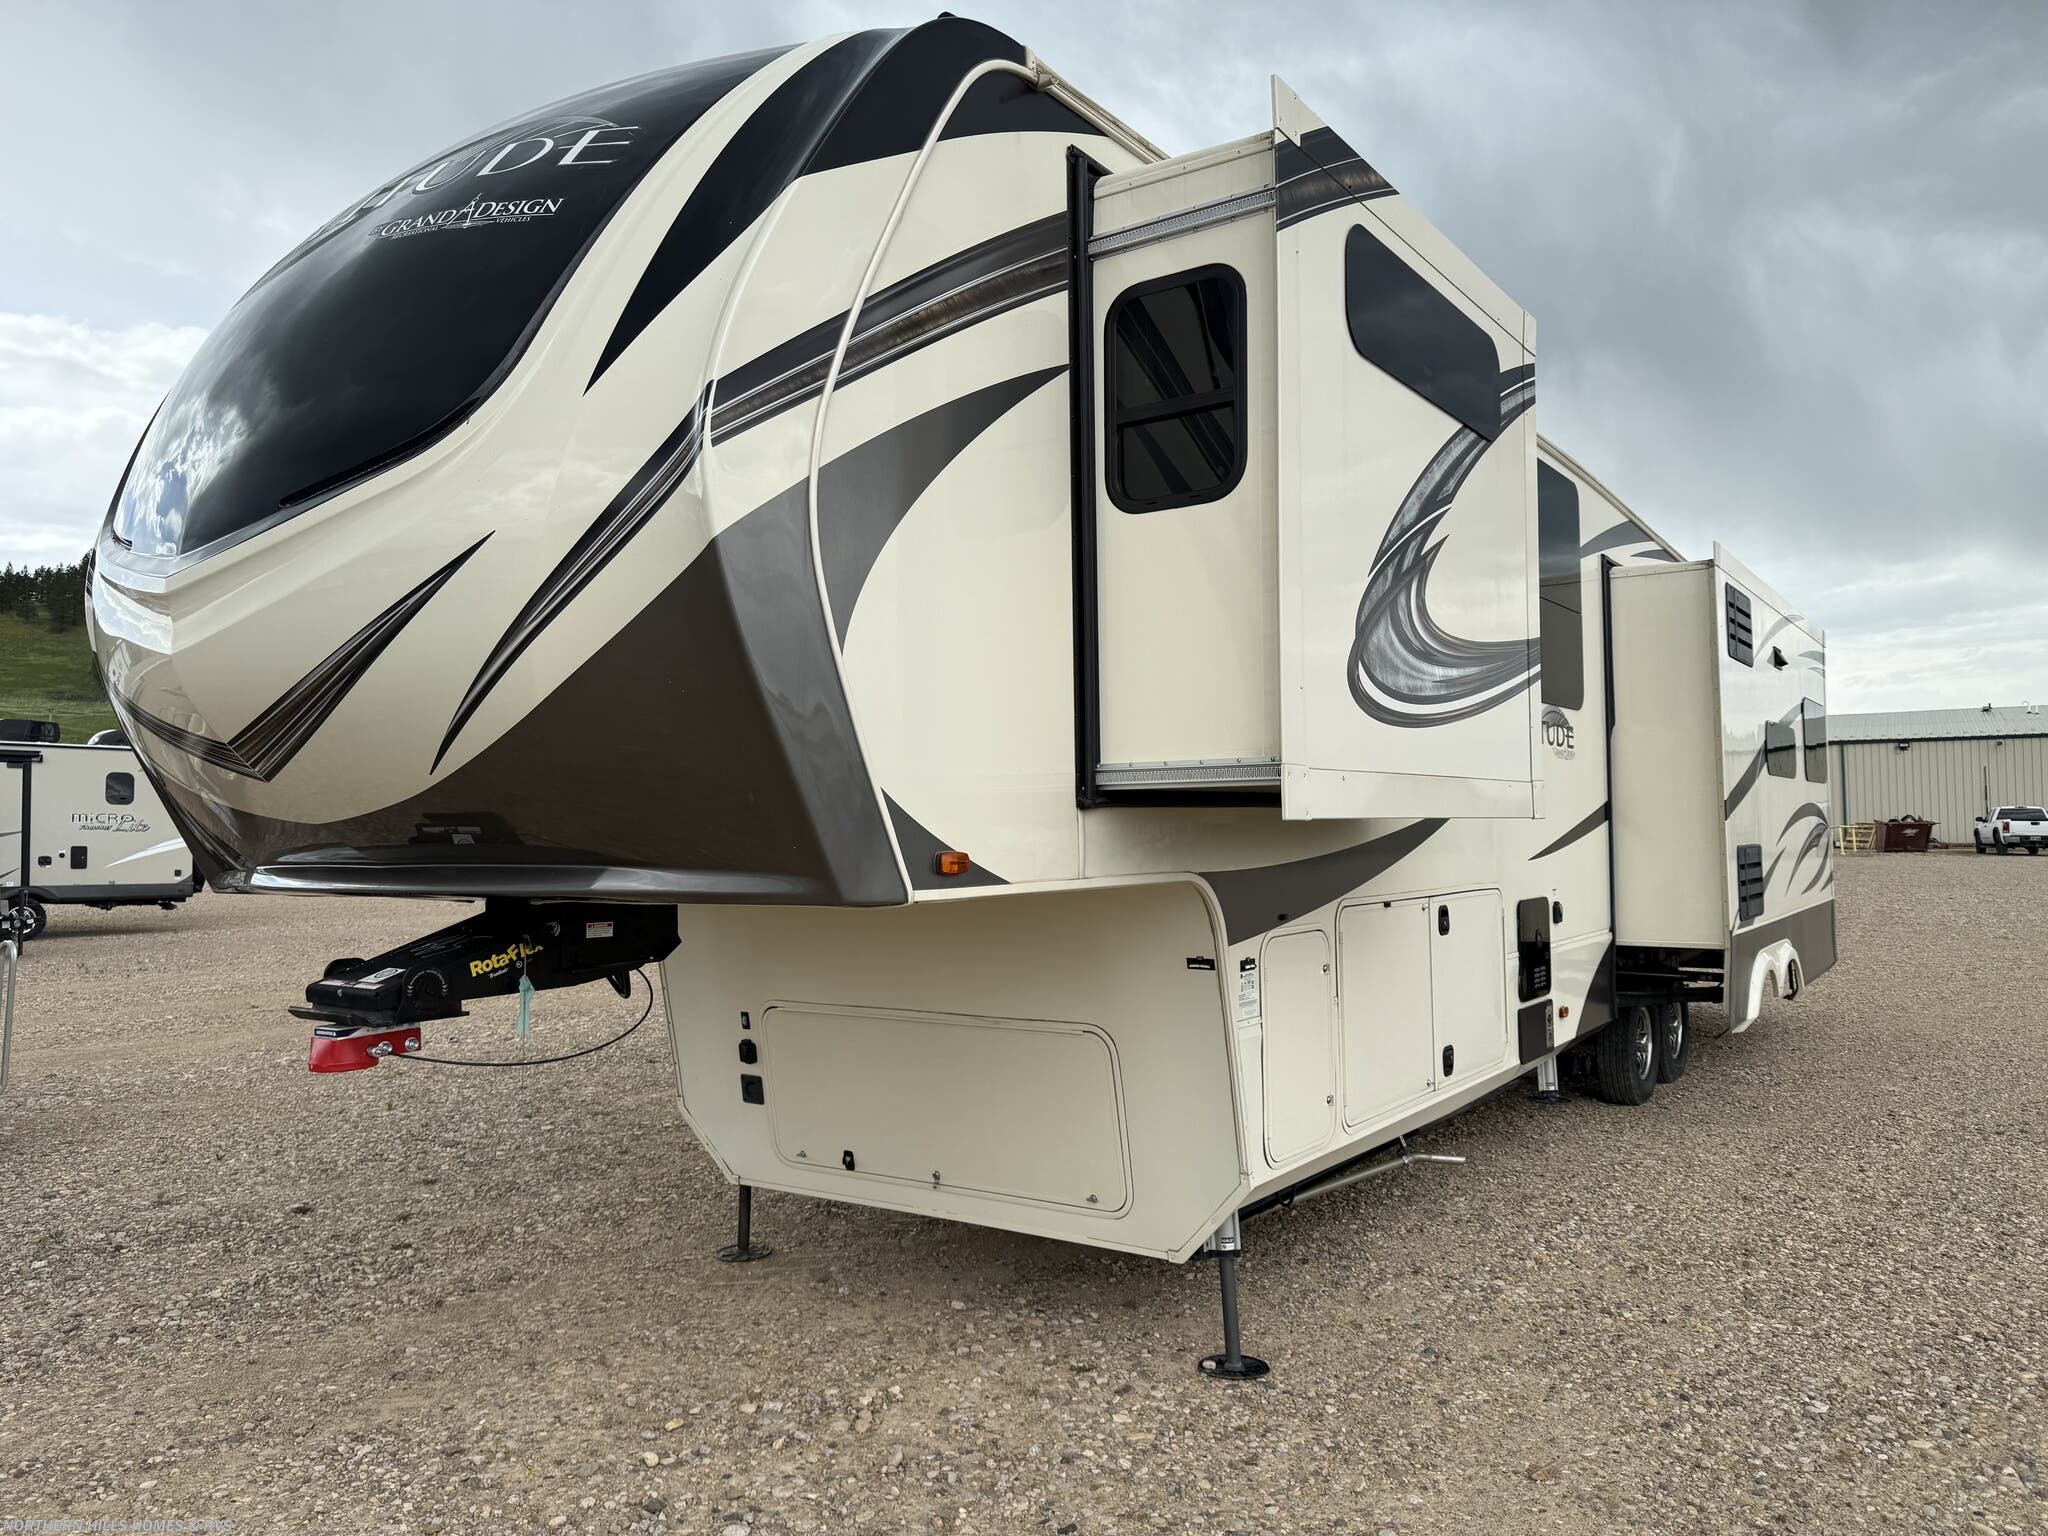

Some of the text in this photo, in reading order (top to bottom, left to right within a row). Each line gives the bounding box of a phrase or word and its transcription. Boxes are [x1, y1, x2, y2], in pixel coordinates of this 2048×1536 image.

[381, 208, 457, 236] GRAND
[473, 198, 566, 218] DESIGN
[496, 216, 531, 224] VEHICLES
